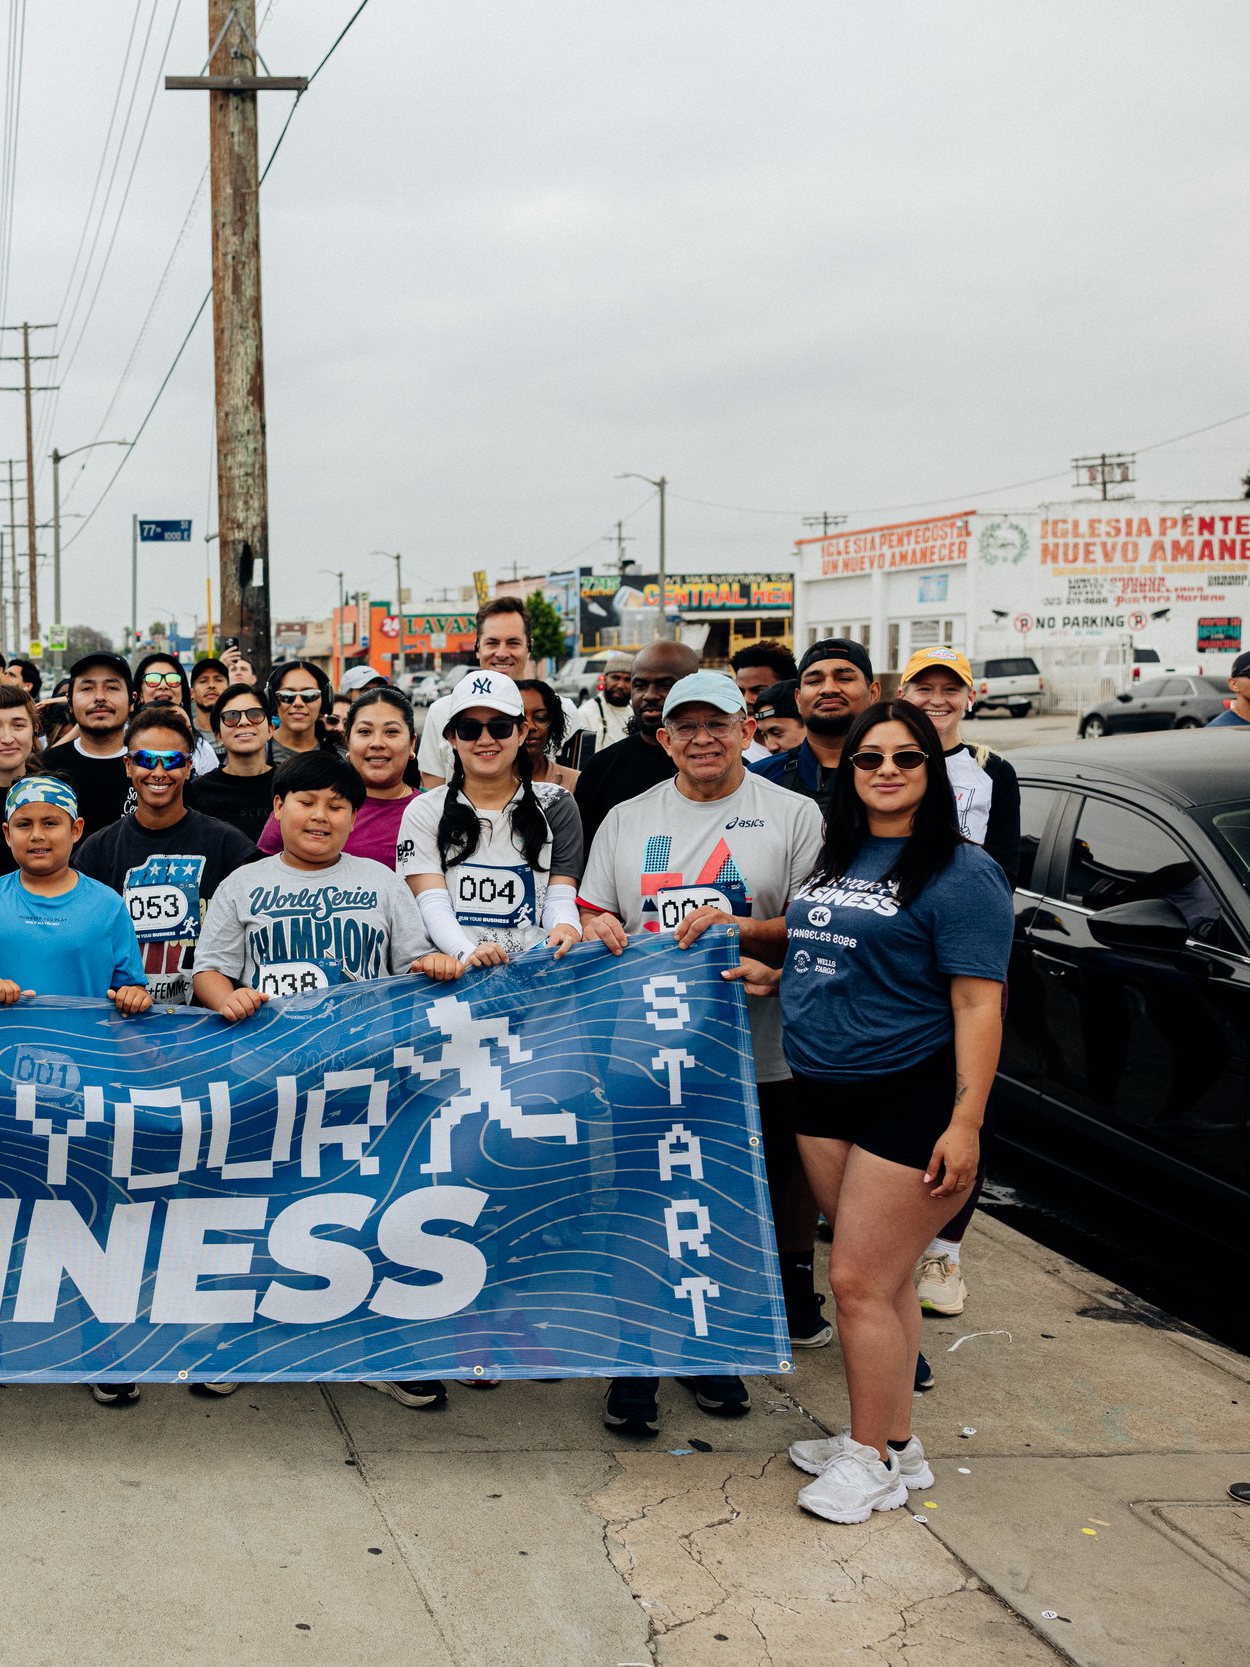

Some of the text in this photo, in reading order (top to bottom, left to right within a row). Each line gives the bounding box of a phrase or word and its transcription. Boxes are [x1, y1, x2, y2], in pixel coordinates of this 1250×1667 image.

[1040, 515, 1250, 539] IGLESIA PENTE
[822, 541, 968, 575] UN NUEVO AMANECER
[1040, 538, 1250, 564] NUEVO AMANE
[643, 582, 748, 607] CENTRAL
[406, 617, 478, 636] LAVAN
[1035, 615, 1125, 629] NO PARKING
[471, 677, 493, 694] NY
[127, 786, 138, 801] So
[459, 875, 516, 905] 004
[794, 885, 902, 917] USINESS
[129, 894, 180, 921] 053
[248, 884, 378, 922] World Series
[811, 910, 829, 923] 5K
[793, 928, 832, 943] ANGELES
[248, 916, 386, 990] CHAMPIONS
[816, 957, 837, 968] WELLS
[814, 965, 836, 975] FARGO
[146, 980, 191, 1000] +FEMME
[262, 971, 318, 997] 038
[15, 1068, 390, 1189] YOUR
[642, 975, 720, 1337] START
